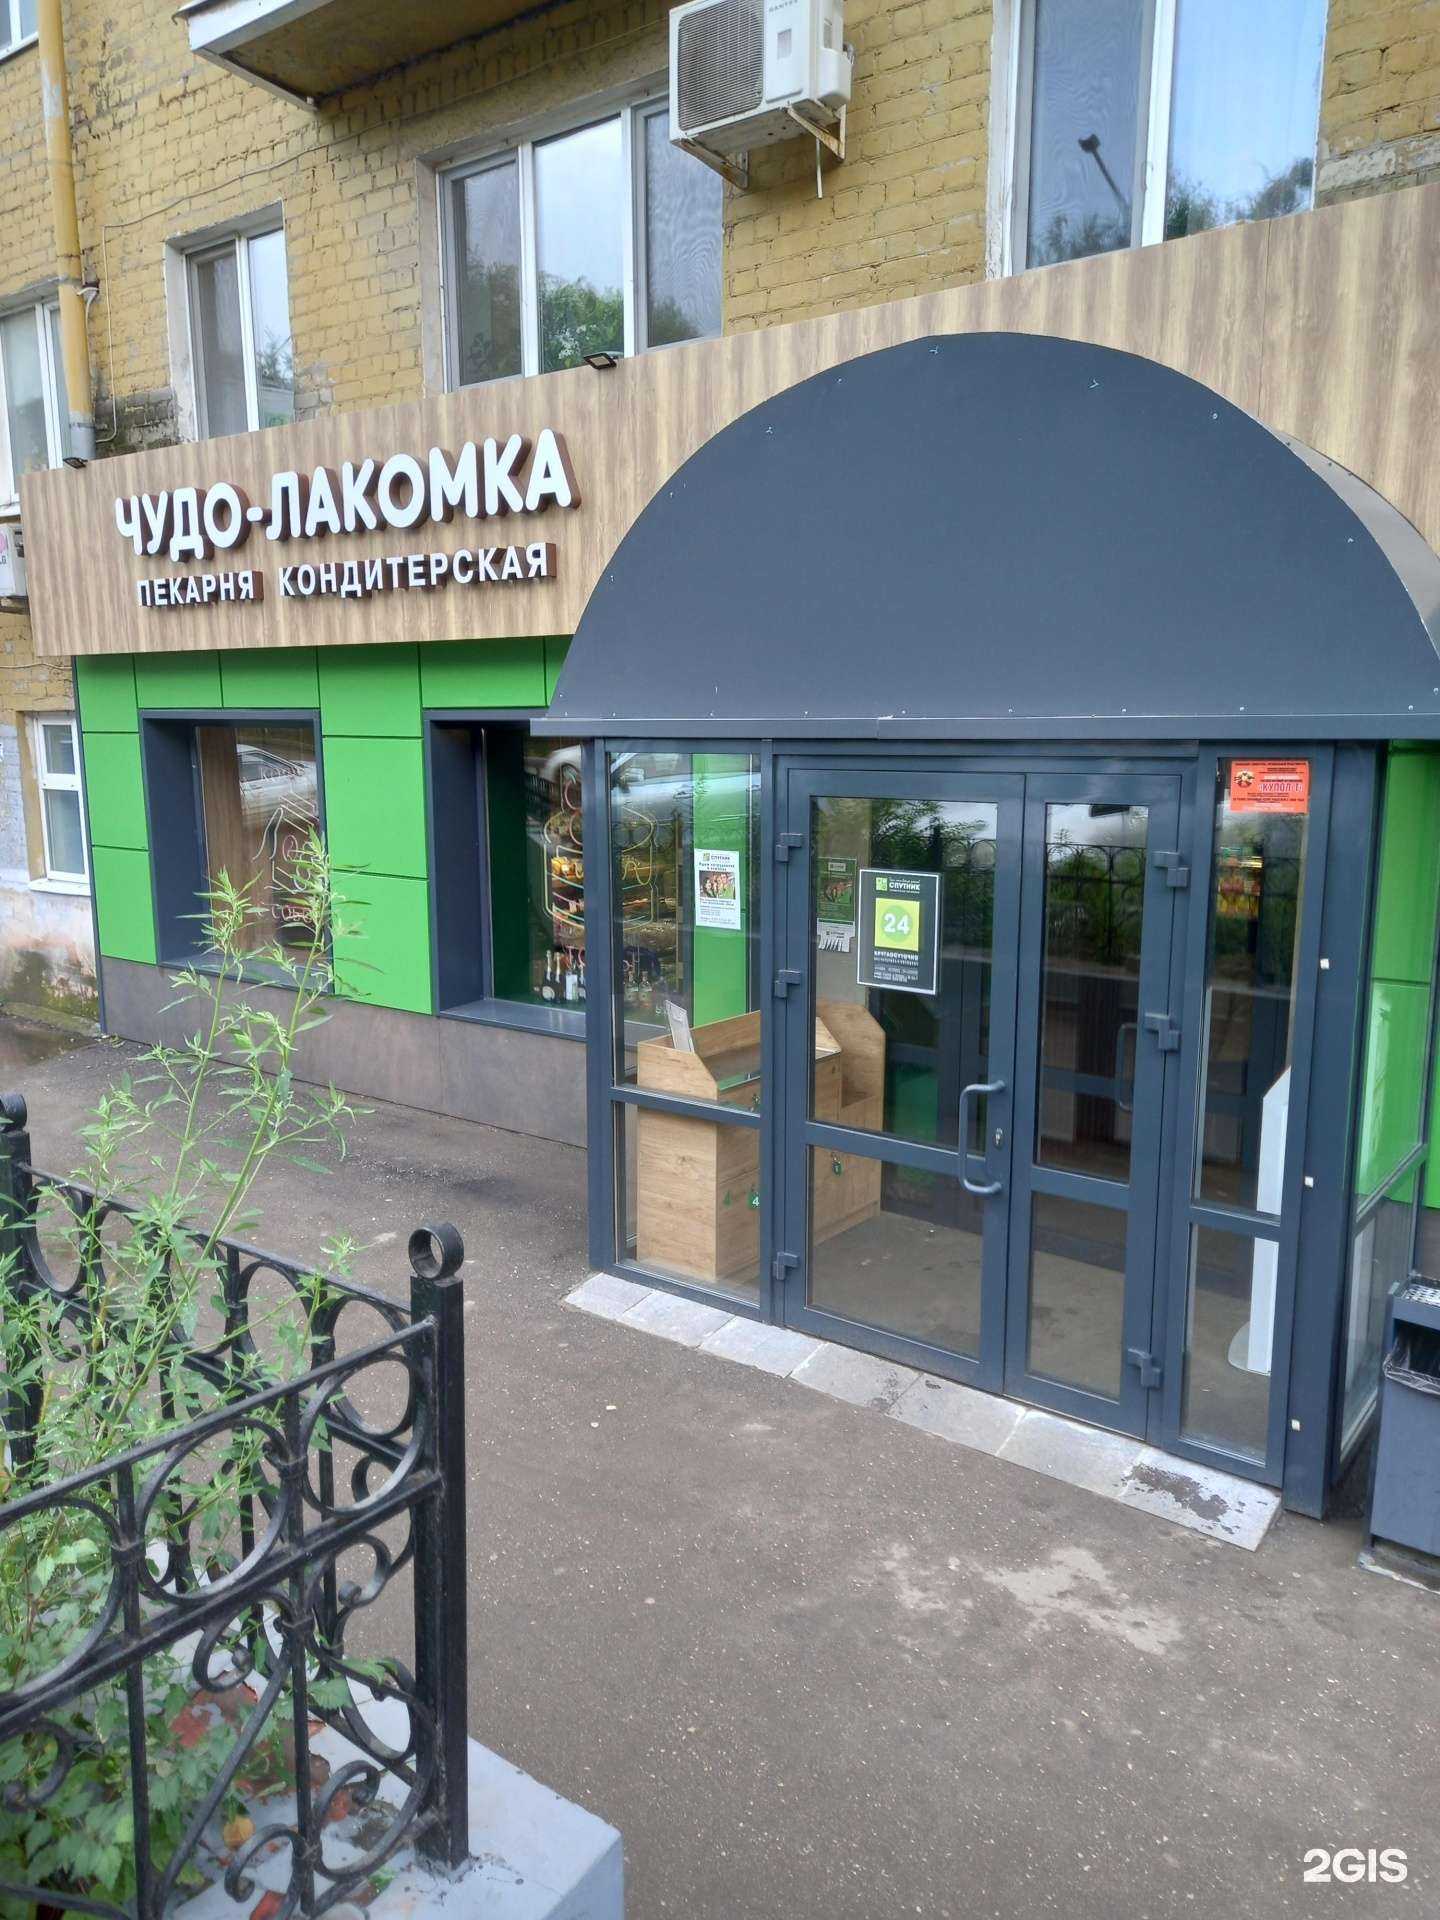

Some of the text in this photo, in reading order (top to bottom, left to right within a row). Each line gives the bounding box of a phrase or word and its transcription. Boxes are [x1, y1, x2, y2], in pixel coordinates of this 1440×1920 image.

[115, 428, 572, 562] ЧУДО-ЛАКОМКА
[136, 542, 549, 607] ПЕКАРНЯ КОНДИТЕРСКАЯ
[889, 882, 920, 891] СПУТНИК
[883, 913, 910, 935] 24
